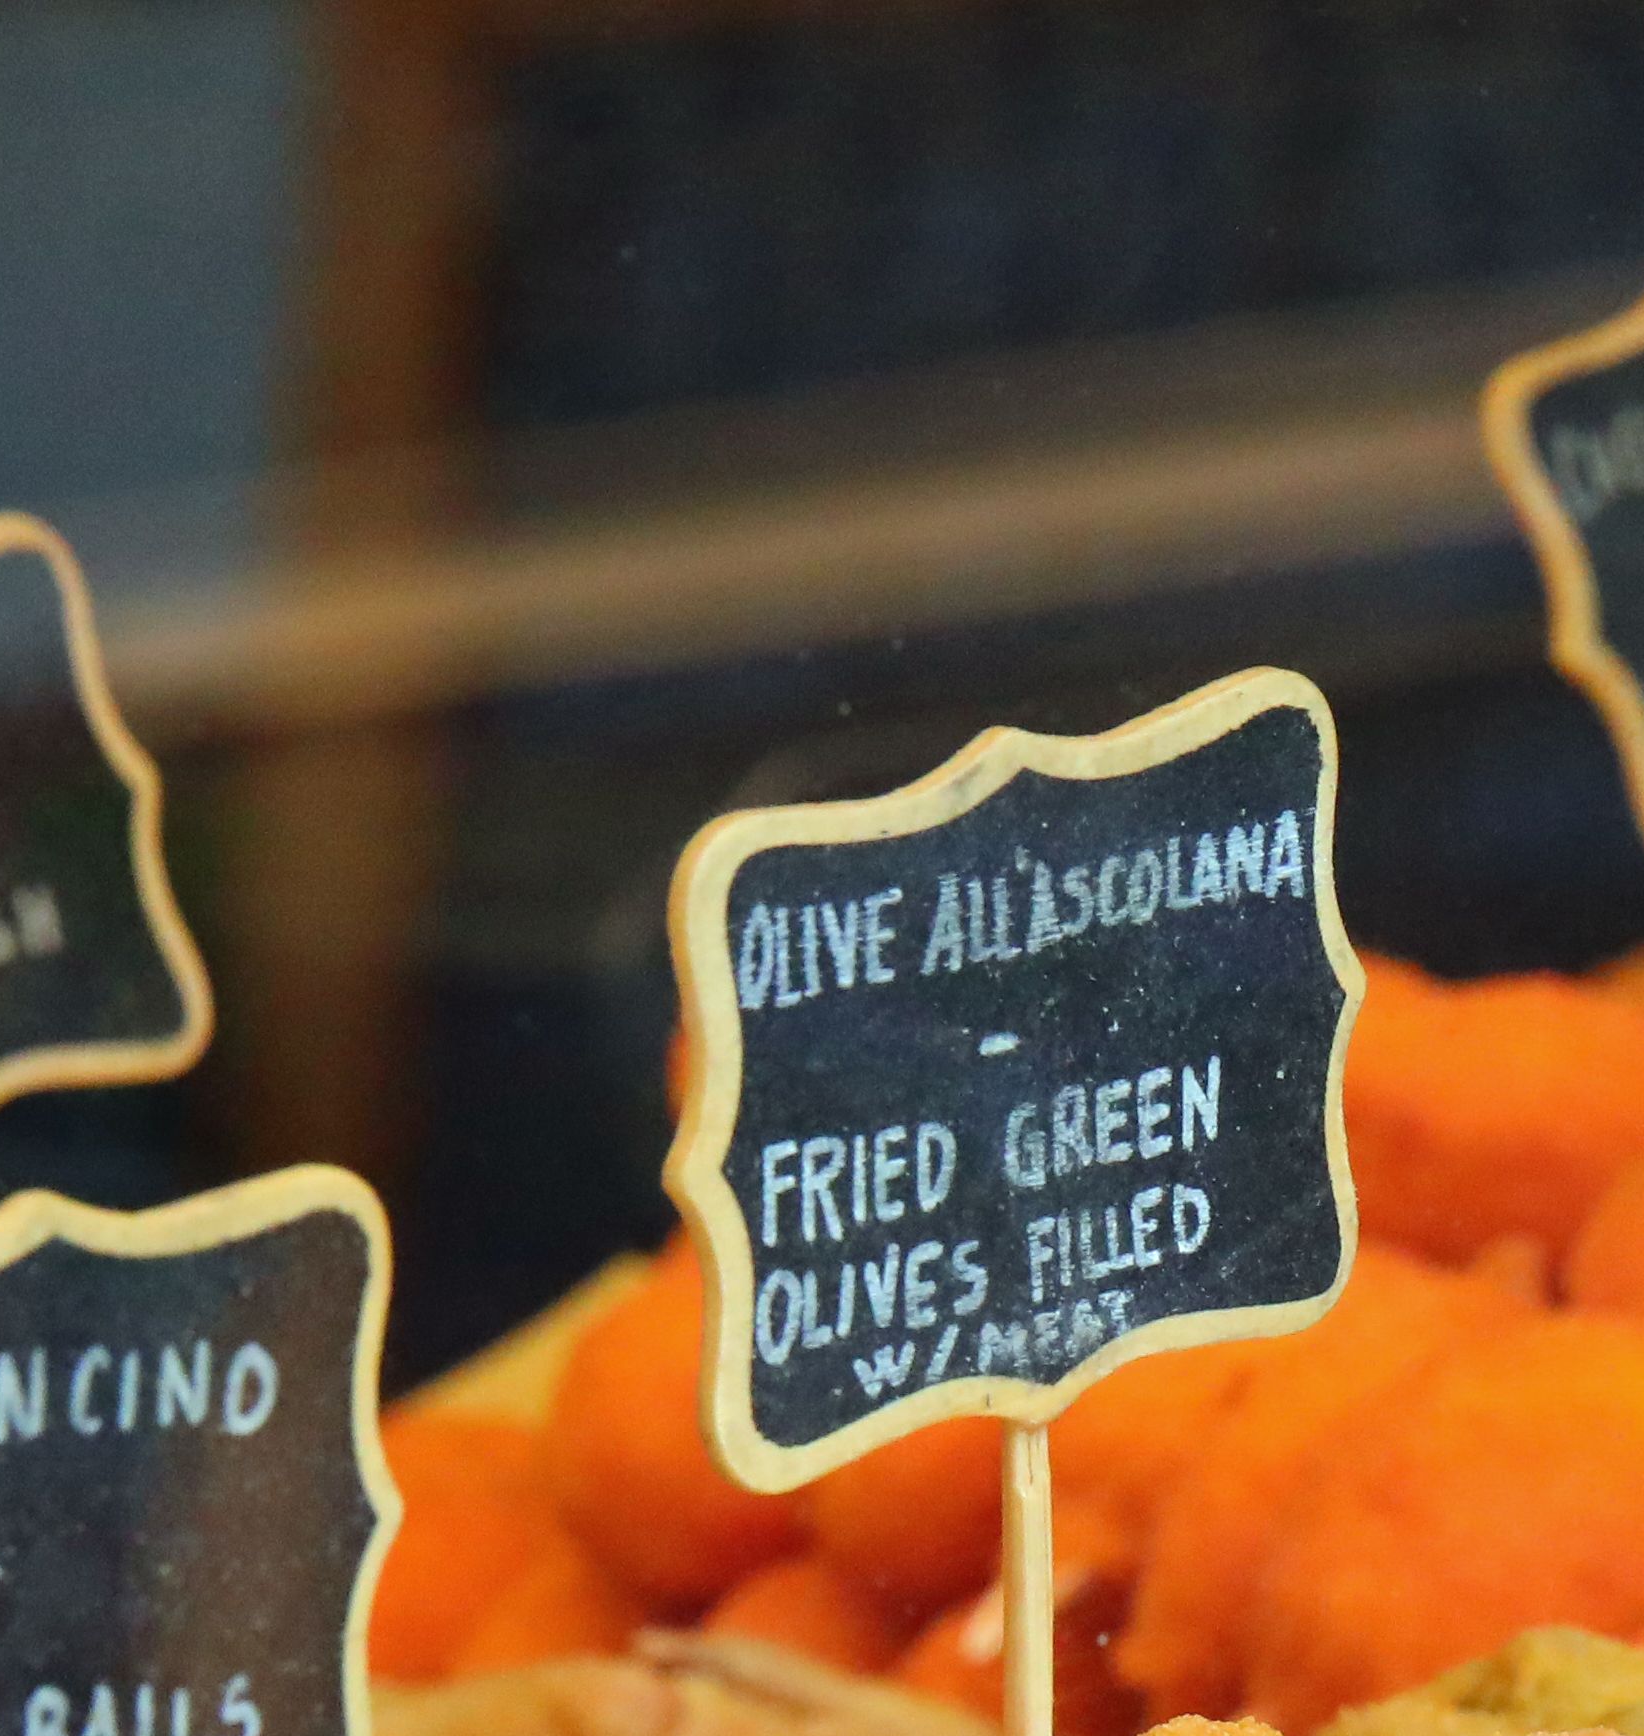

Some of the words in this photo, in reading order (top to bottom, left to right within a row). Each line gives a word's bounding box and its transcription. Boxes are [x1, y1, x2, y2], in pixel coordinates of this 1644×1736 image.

[736, 887, 903, 1010] OLIVE
[920, 809, 1307, 975] ALL'ASCOLANA
[760, 1120, 956, 1248] FRIED
[1003, 1055, 1222, 1189] GREEN
[756, 1239, 988, 1367] OLIVES
[1027, 1184, 1213, 1302] FILLED
